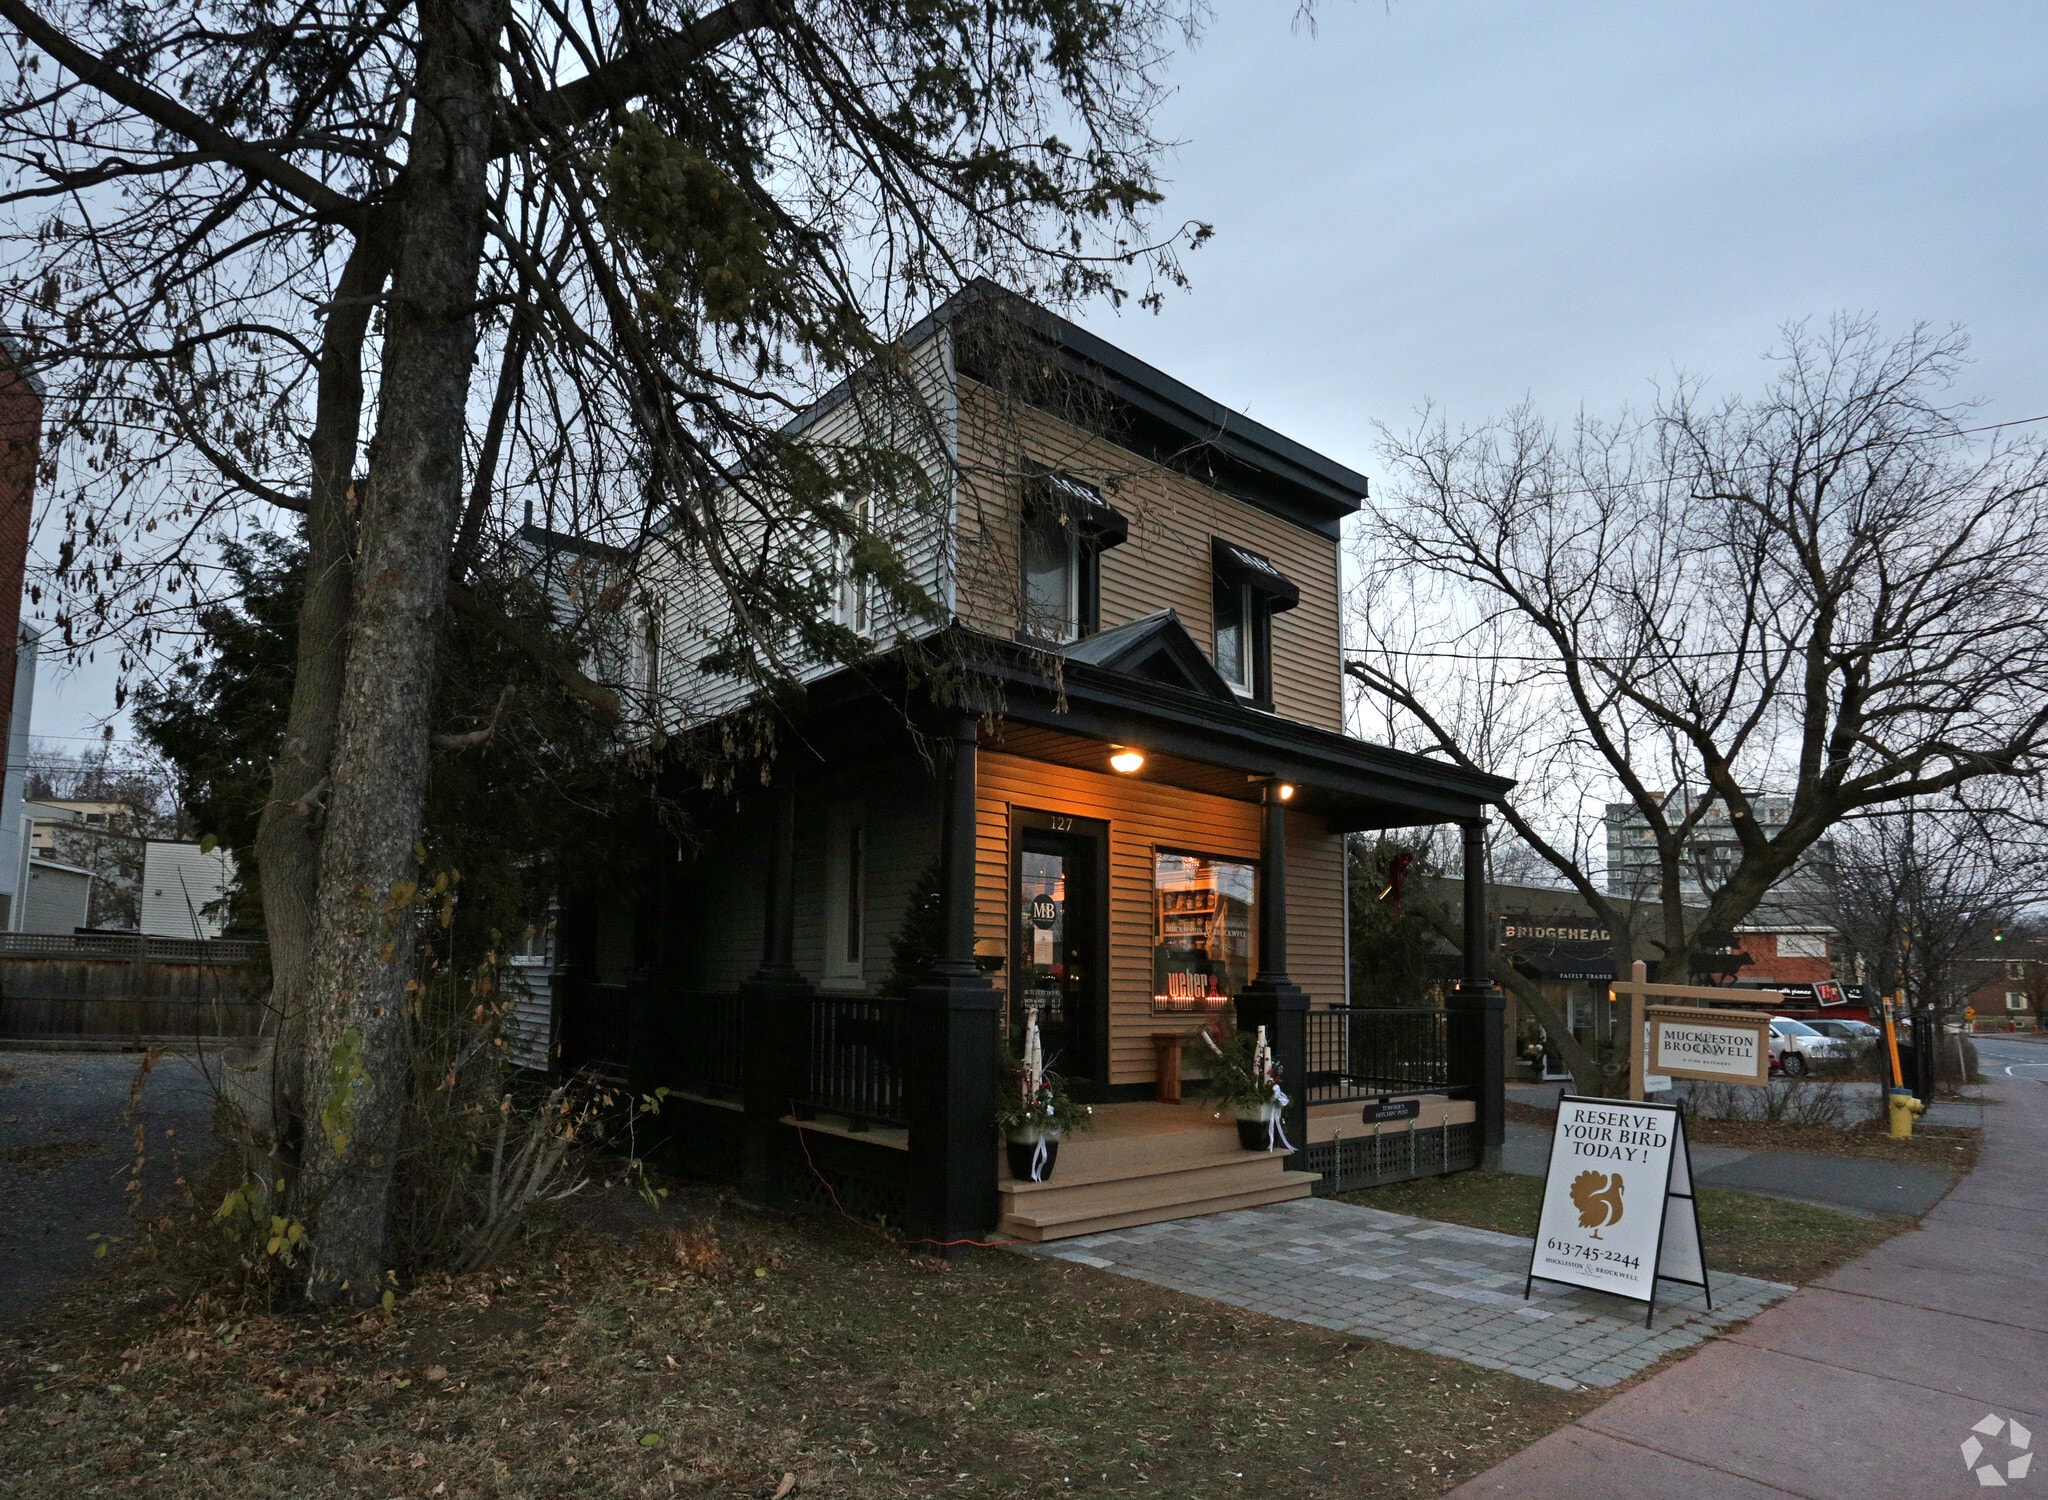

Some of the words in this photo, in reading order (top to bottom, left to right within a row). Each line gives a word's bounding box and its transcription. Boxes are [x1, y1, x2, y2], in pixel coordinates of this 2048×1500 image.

[1051, 816, 1072, 831] 127
[1505, 926, 1610, 940] BRIDGEHEAD
[1168, 968, 1208, 998] weber
[1664, 1031, 1753, 1047] MUCKLESTON
[1664, 1041, 1753, 1058] BROCKWELL
[1574, 1109, 1658, 1131] RESERVE
[1563, 1124, 1613, 1142] YOUR
[1618, 1129, 1667, 1148] BIRD
[1547, 1237, 1640, 1270] 613-745-2244
[1545, 1257, 1584, 1269] MUCKLESTON
[1595, 1267, 1639, 1281] BROCKWELL
